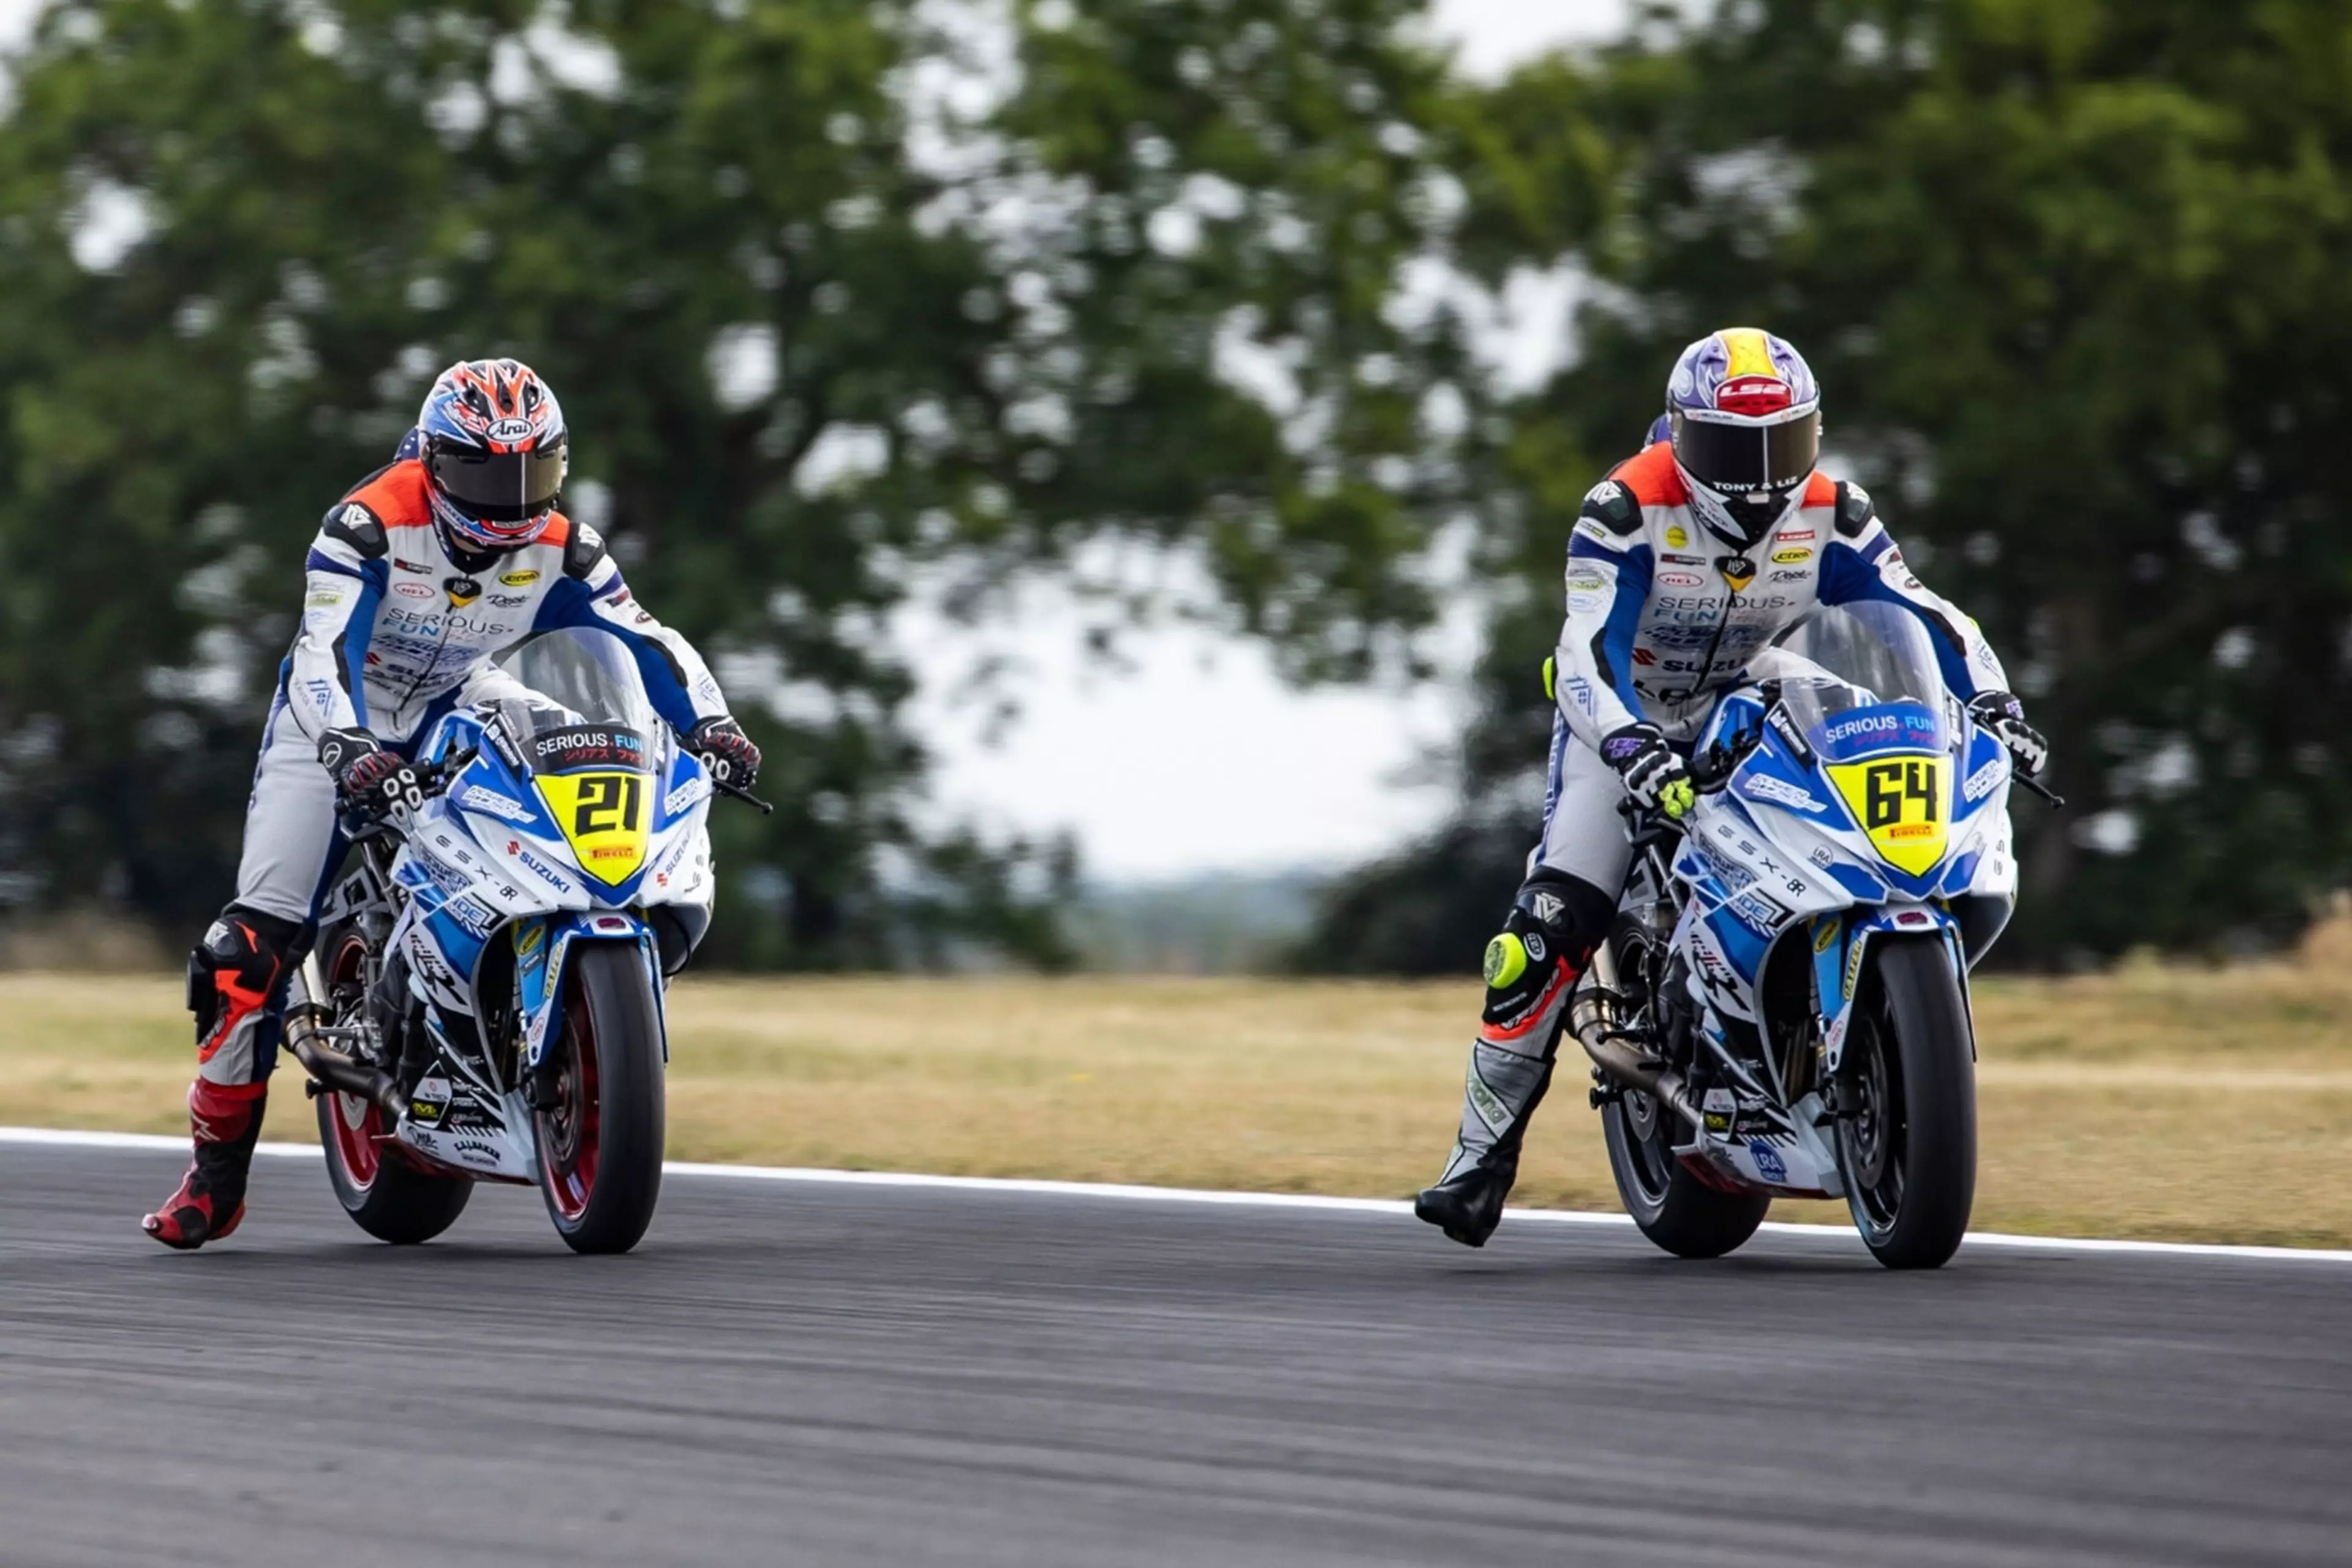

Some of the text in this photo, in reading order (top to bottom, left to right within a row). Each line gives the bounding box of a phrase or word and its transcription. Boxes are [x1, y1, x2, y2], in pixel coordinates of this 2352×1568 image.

[1719, 383, 1787, 398] LS2
[491, 421, 527, 436] Arai
[1713, 481, 1756, 491] TONY
[1777, 476, 1798, 488] LIZ
[382, 617, 439, 636] FUN
[388, 608, 505, 635] SERIOUS
[1825, 715, 1898, 744] SERIOUS
[1905, 715, 1935, 731] FUN
[535, 733, 608, 756] SERIOUS
[614, 734, 643, 752] FUN
[575, 776, 641, 837] 21
[1867, 762, 1937, 831] 64
[519, 851, 571, 894] SUZUKI
[1755, 1153, 1782, 1171] LRA
